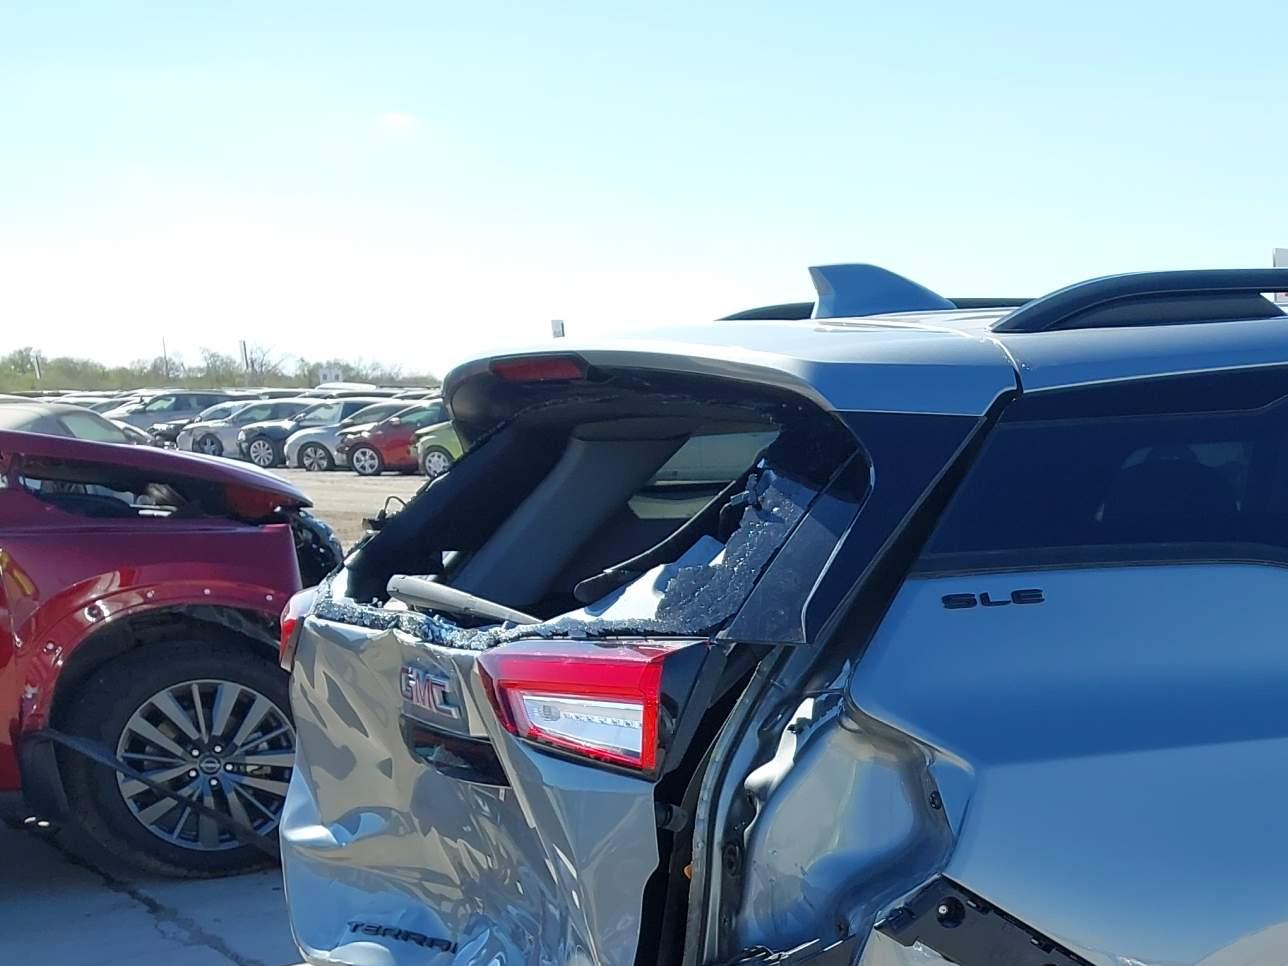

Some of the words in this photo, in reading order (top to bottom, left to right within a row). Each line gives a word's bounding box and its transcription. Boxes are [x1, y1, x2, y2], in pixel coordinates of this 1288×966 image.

[941, 588, 1046, 610] SLE
[400, 666, 459, 719] GMC
[347, 921, 458, 954] TERRAI
